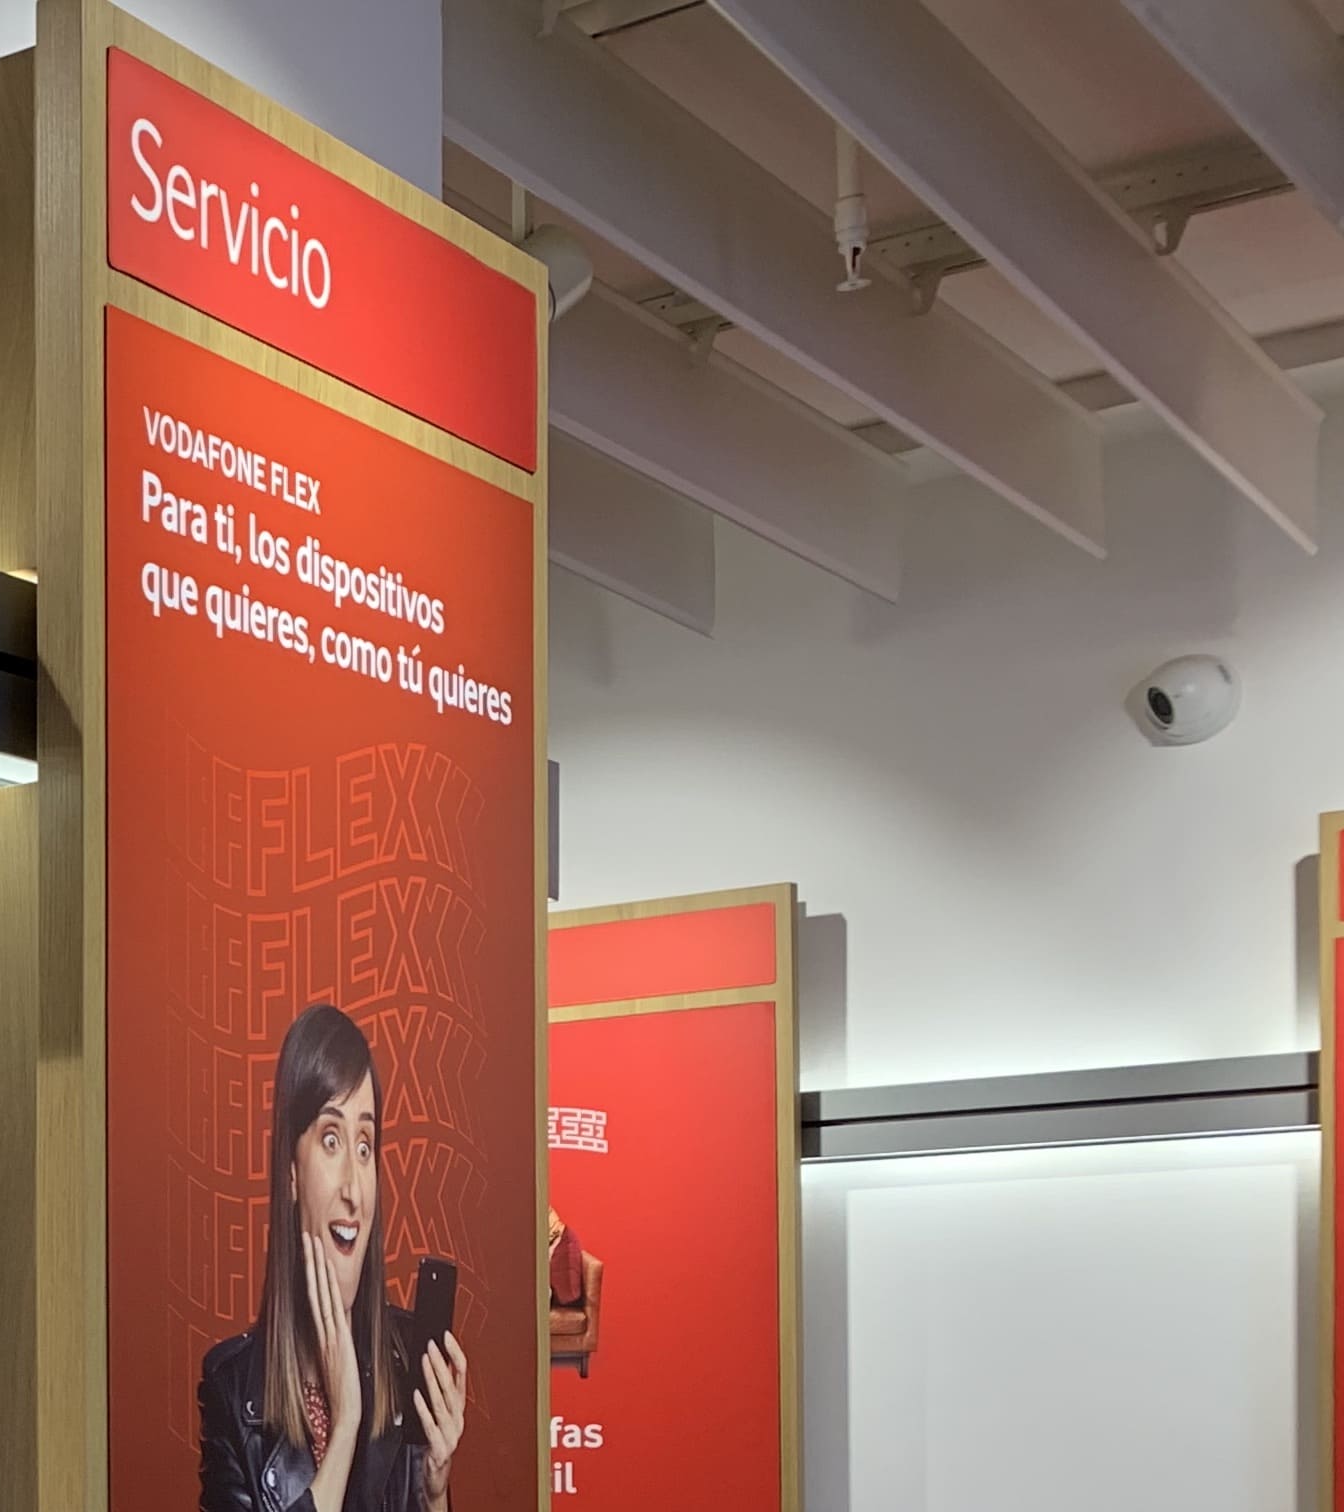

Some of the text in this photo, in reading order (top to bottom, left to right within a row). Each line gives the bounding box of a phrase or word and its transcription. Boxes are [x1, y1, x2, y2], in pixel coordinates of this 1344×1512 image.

[130, 118, 332, 309] Servicio
[142, 406, 321, 515] VODAFONE FLEX
[142, 470, 445, 634] Para ti, los dispositivos
[141, 561, 512, 725] que quieres, como tú quieres
[550, 1415, 603, 1449] fas
